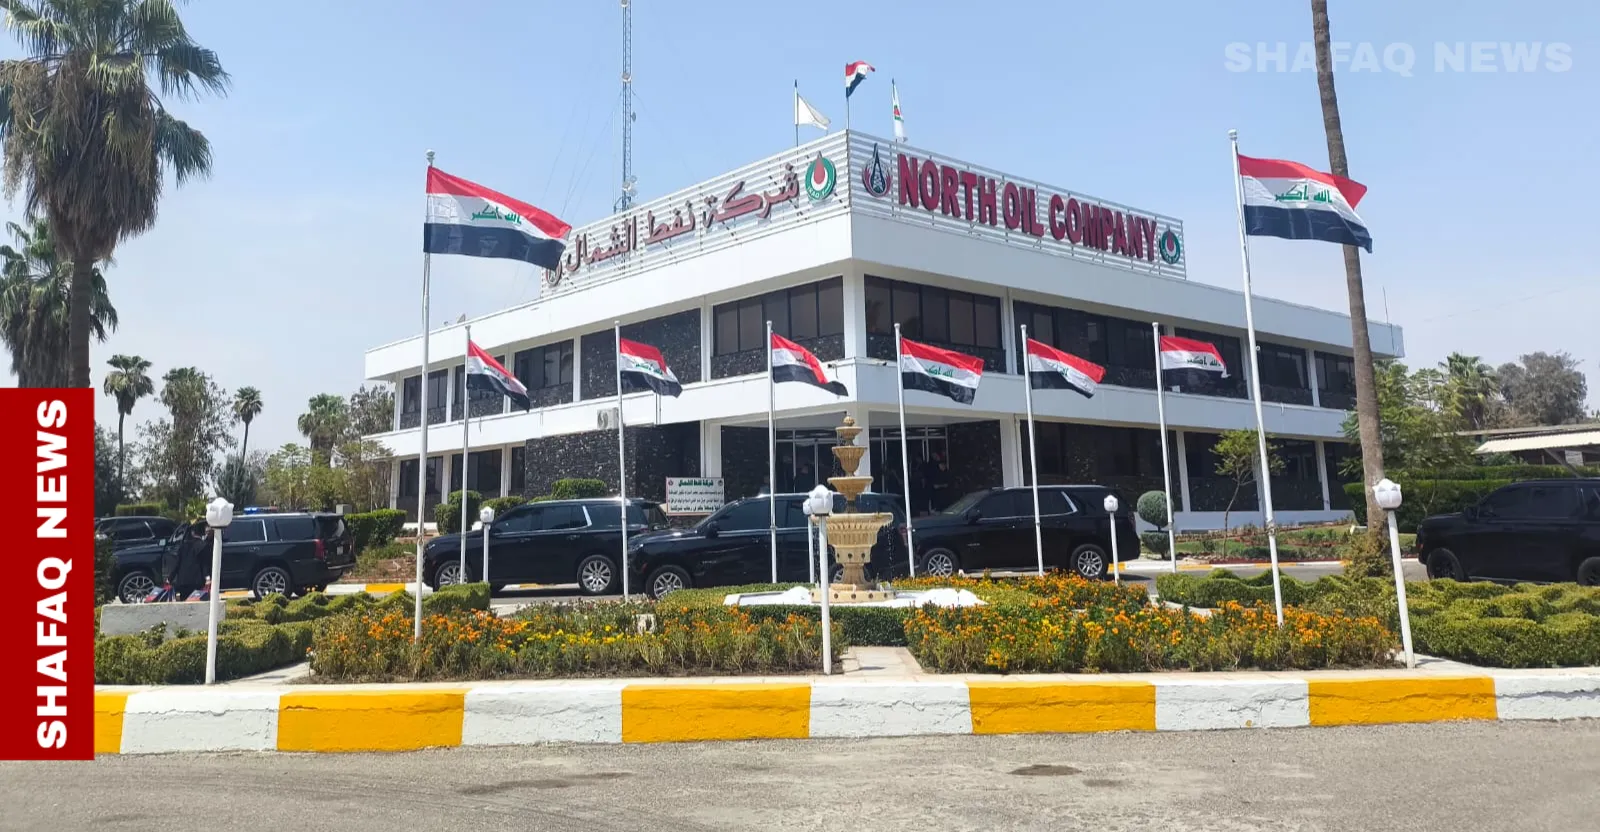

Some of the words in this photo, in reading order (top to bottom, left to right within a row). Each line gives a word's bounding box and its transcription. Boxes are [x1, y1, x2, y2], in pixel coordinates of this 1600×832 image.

[644, 200, 695, 246] نفط
[702, 162, 799, 228] شركة
[897, 153, 997, 226] NORTH
[1002, 181, 1044, 238] OIL
[1049, 193, 1157, 262] COMPANY
[566, 215, 636, 272] الشمال
